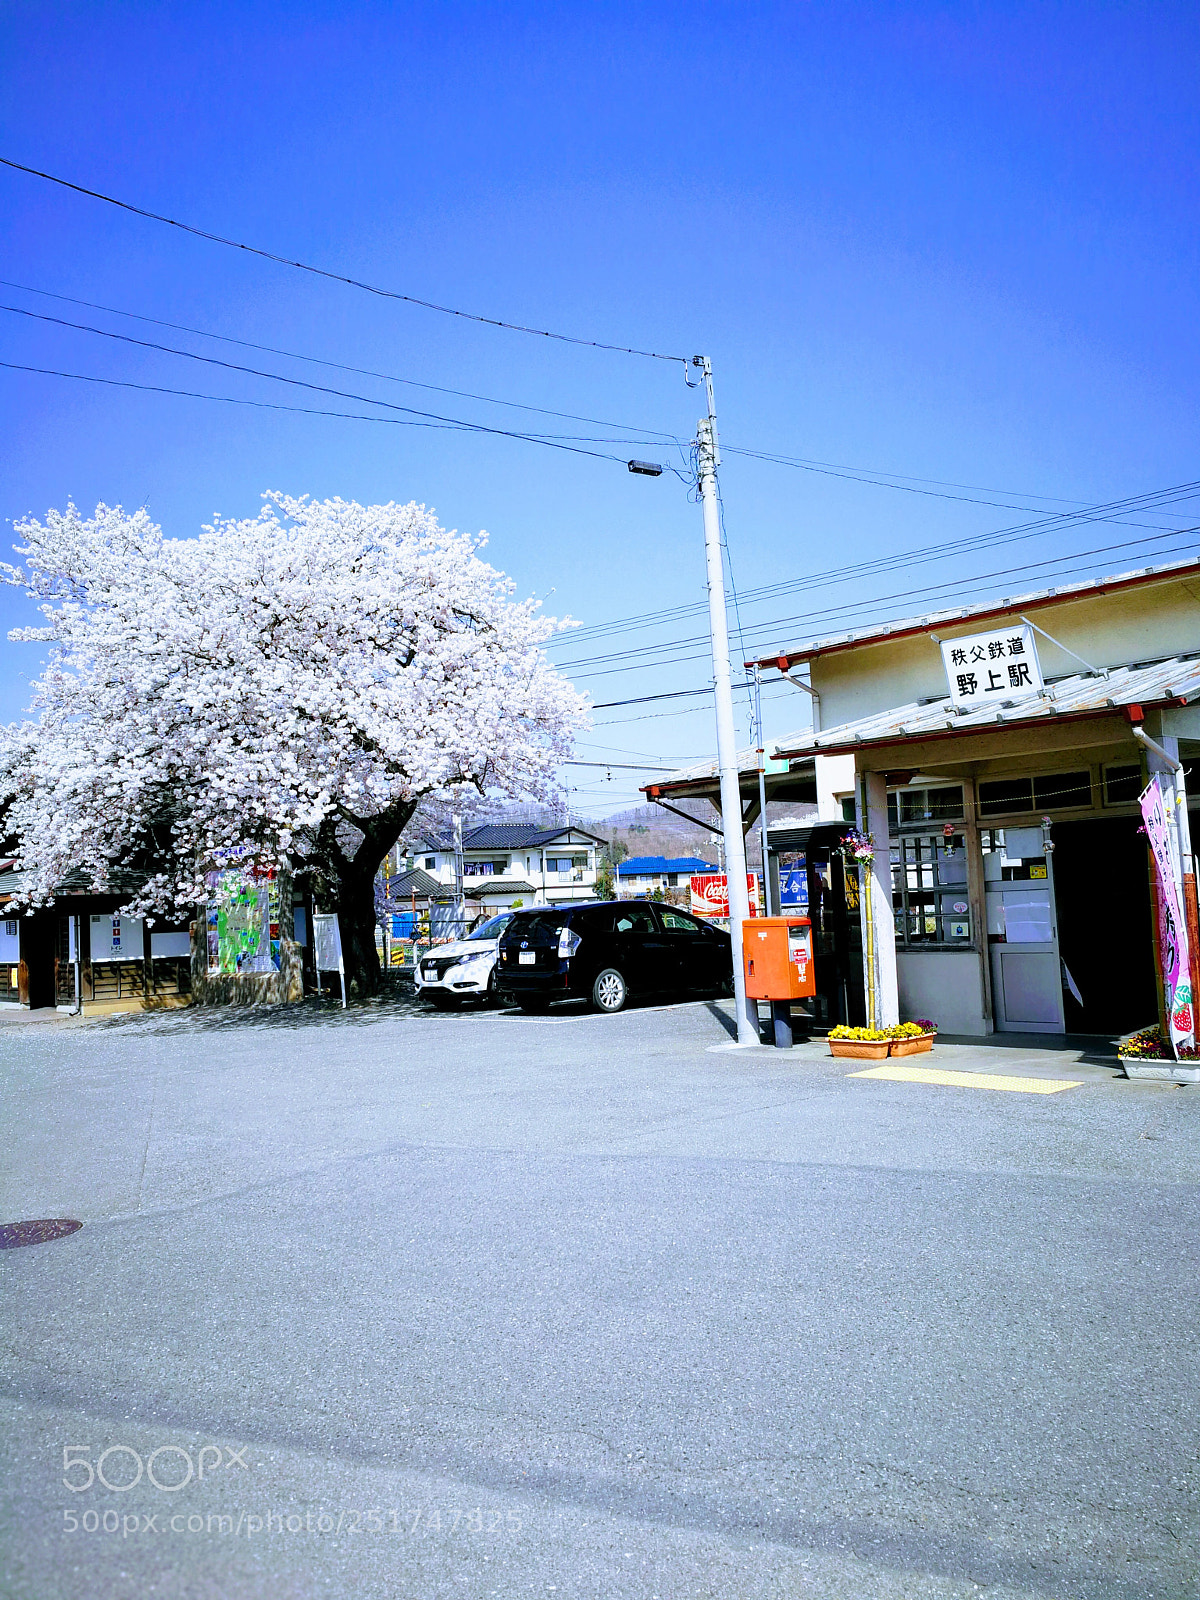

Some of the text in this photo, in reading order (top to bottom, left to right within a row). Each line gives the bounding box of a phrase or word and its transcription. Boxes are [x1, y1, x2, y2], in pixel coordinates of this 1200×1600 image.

[950, 636, 1026, 667] 秩父鉄道
[956, 662, 1033, 697] 野上駅
